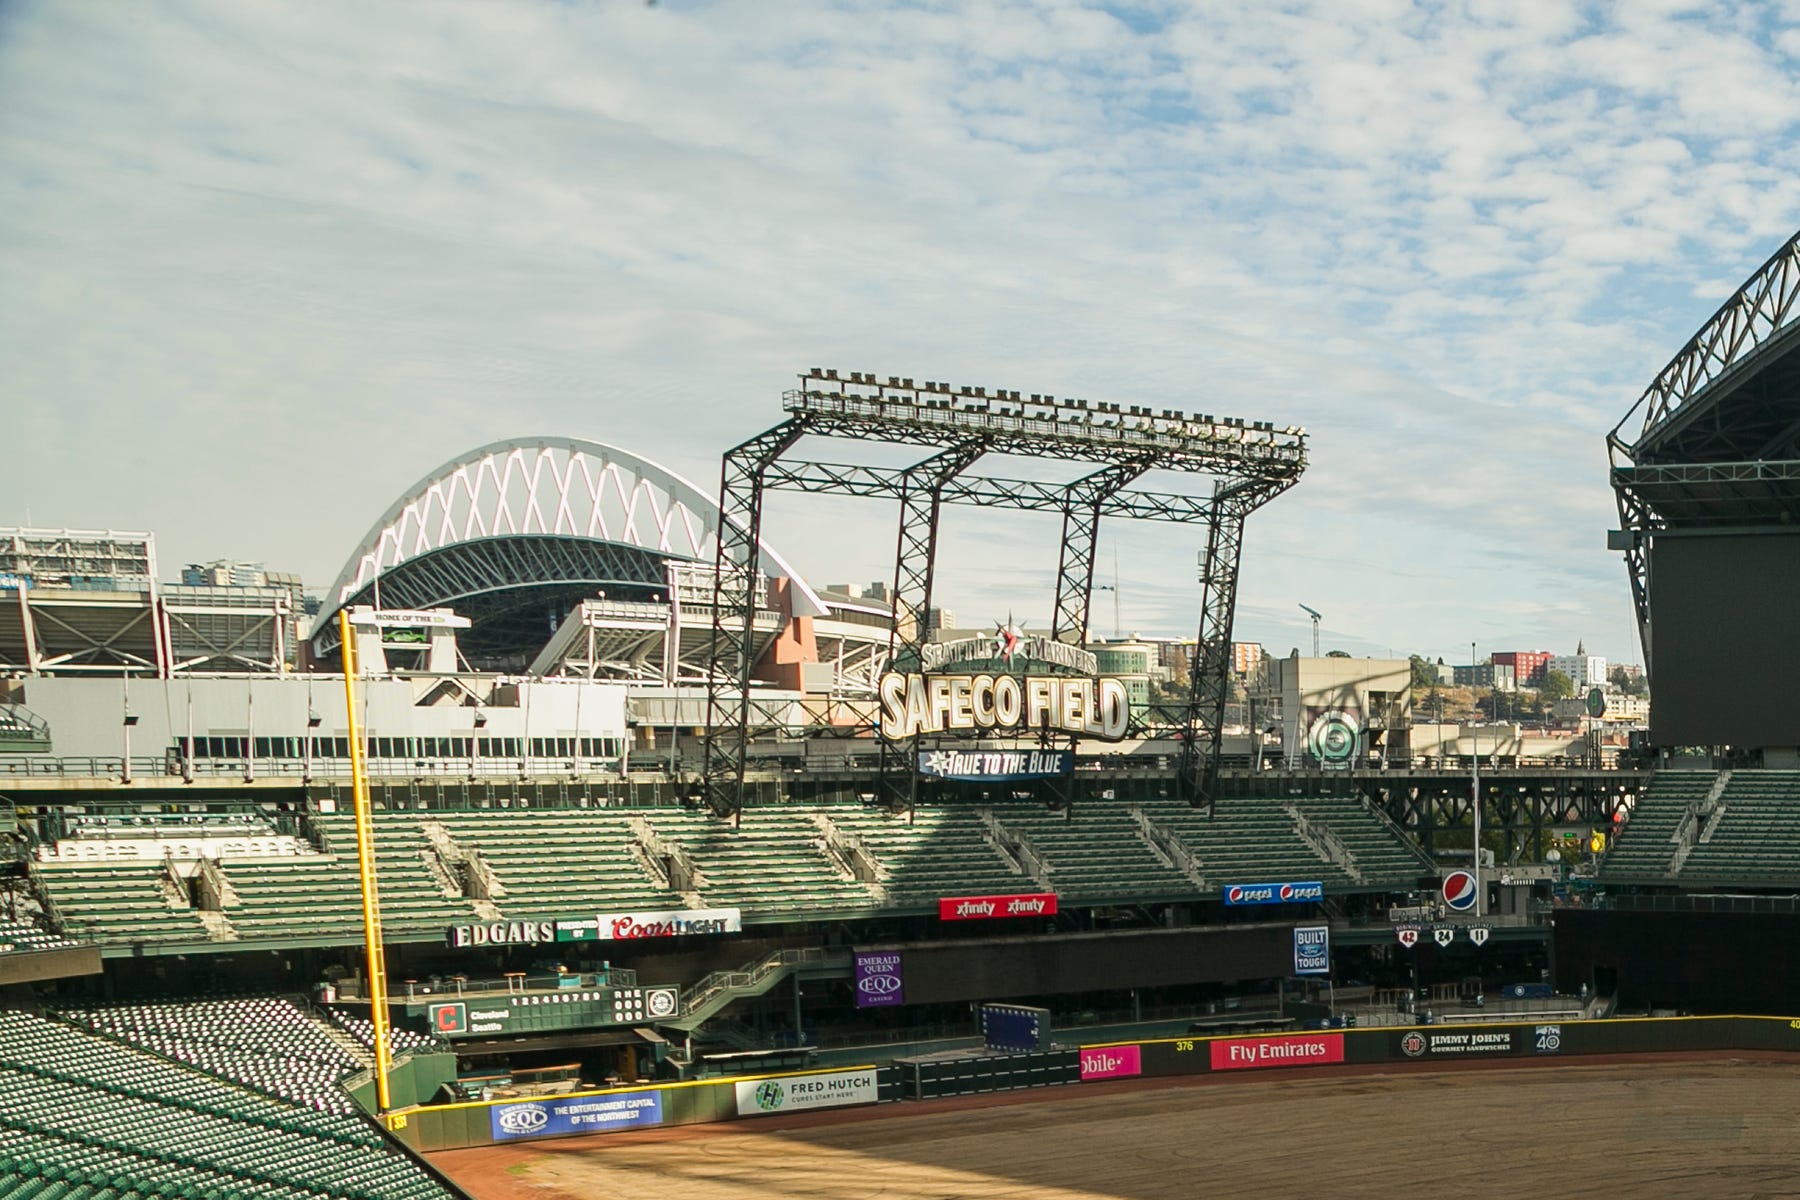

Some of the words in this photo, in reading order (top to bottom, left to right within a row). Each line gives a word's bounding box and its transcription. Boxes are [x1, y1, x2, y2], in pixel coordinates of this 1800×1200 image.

[922, 638, 993, 672] SEATTLE
[1028, 634, 1098, 675] MARINERS
[880, 672, 1022, 739] SAFECO
[1026, 675, 1130, 742] FIELD
[948, 751, 981, 775] TRUE
[983, 752, 999, 774] TO
[1000, 751, 1027, 774] THE
[1028, 752, 1063, 774] BLUE
[1244, 888, 1272, 901] pepsi
[1295, 886, 1321, 899] pepsi
[957, 900, 995, 917] xfinity
[1008, 899, 1045, 915] xfinity
[455, 922, 554, 947] EDGARS
[572, 929, 584, 938] BY
[611, 917, 673, 940] Coors
[676, 918, 727, 934] LIGHT
[1298, 932, 1325, 944] BUILT
[1402, 932, 1414, 942] 42
[1438, 931, 1450, 941] 24
[1475, 931, 1484, 940] 11
[858, 956, 900, 966] EMERALD
[1298, 958, 1325, 968] TOUGH
[864, 965, 893, 973] QUEEN
[862, 976, 900, 994] EQC
[625, 990, 632, 998] H
[634, 990, 641, 998] E
[437, 1007, 456, 1030] C
[470, 1010, 509, 1020] Cleveland
[471, 1022, 502, 1032] Seattle
[1431, 1035, 1469, 1045] JIMMY
[1472, 1034, 1510, 1045] JOHN'S
[1176, 1041, 1194, 1051] 376
[1230, 1045, 1256, 1062] Fly
[1260, 1041, 1326, 1059] Emirates
[1467, 1044, 1511, 1052] SANDWICHES
[791, 1081, 824, 1094] FRED
[828, 1077, 871, 1091] HUTCH
[792, 1095, 813, 1103] CURES
[815, 1092, 835, 1101] START
[554, 1107, 568, 1115] THE
[569, 1101, 626, 1114] ENTERTAINMENT
[627, 1098, 655, 1108] CAPITAL
[504, 1110, 546, 1129] EQC
[571, 1116, 581, 1124] OF
[582, 1114, 596, 1123] THE
[597, 1110, 639, 1122] NORTHWEST
